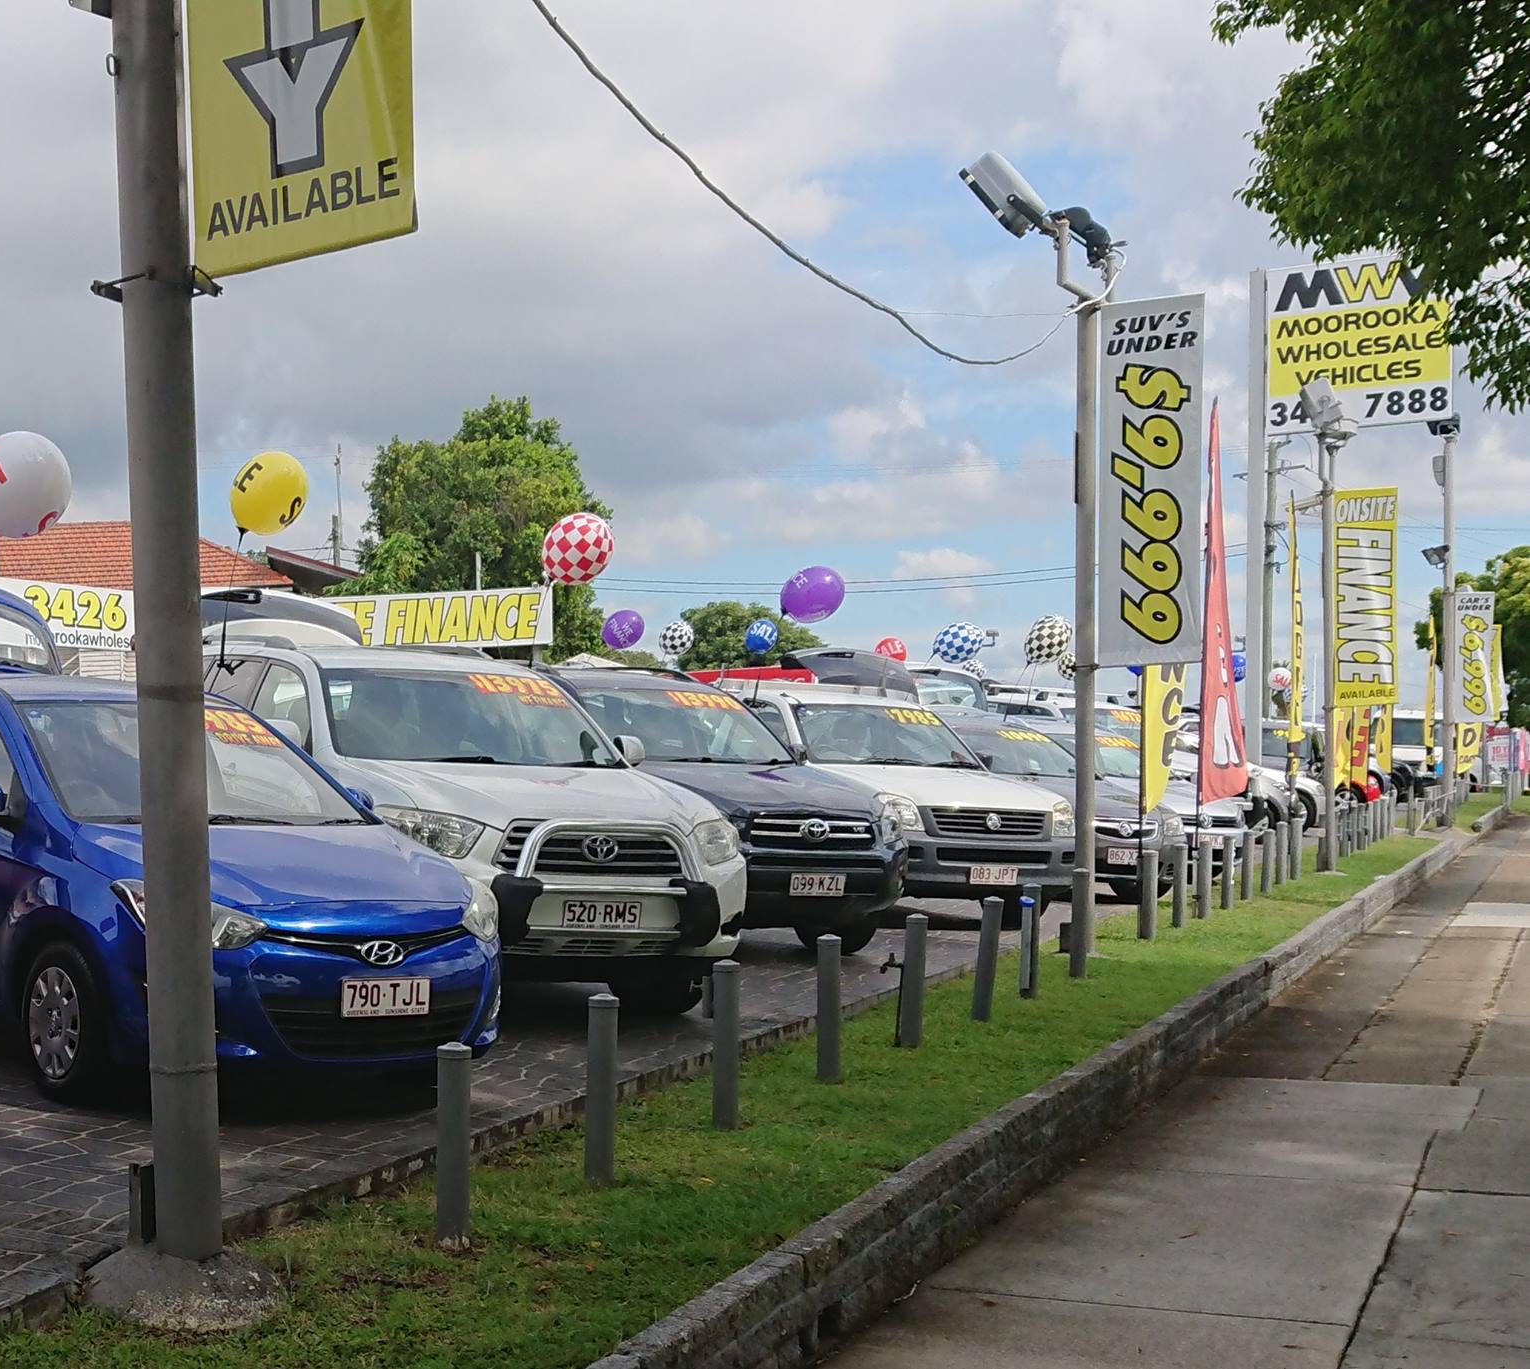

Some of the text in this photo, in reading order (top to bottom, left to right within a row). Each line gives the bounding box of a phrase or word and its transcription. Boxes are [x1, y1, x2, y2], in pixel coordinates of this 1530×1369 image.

[222, 0, 365, 180] Y
[206, 157, 401, 241] AVAILABLE
[1113, 310, 1192, 336] SUV'S
[1276, 305, 1440, 340] MOOROOKA
[1106, 331, 1198, 357] UNDER
[1276, 329, 1445, 365] WHOLESALE
[1365, 386, 1448, 419] 7888
[1335, 495, 1397, 523] ONSITE
[24, 585, 127, 631] 3426
[384, 593, 541, 646] FINANCE
[1336, 526, 1394, 686] FINANCE
[1457, 604, 1491, 612] UNDER
[1339, 687, 1396, 701] AVAILABLE
